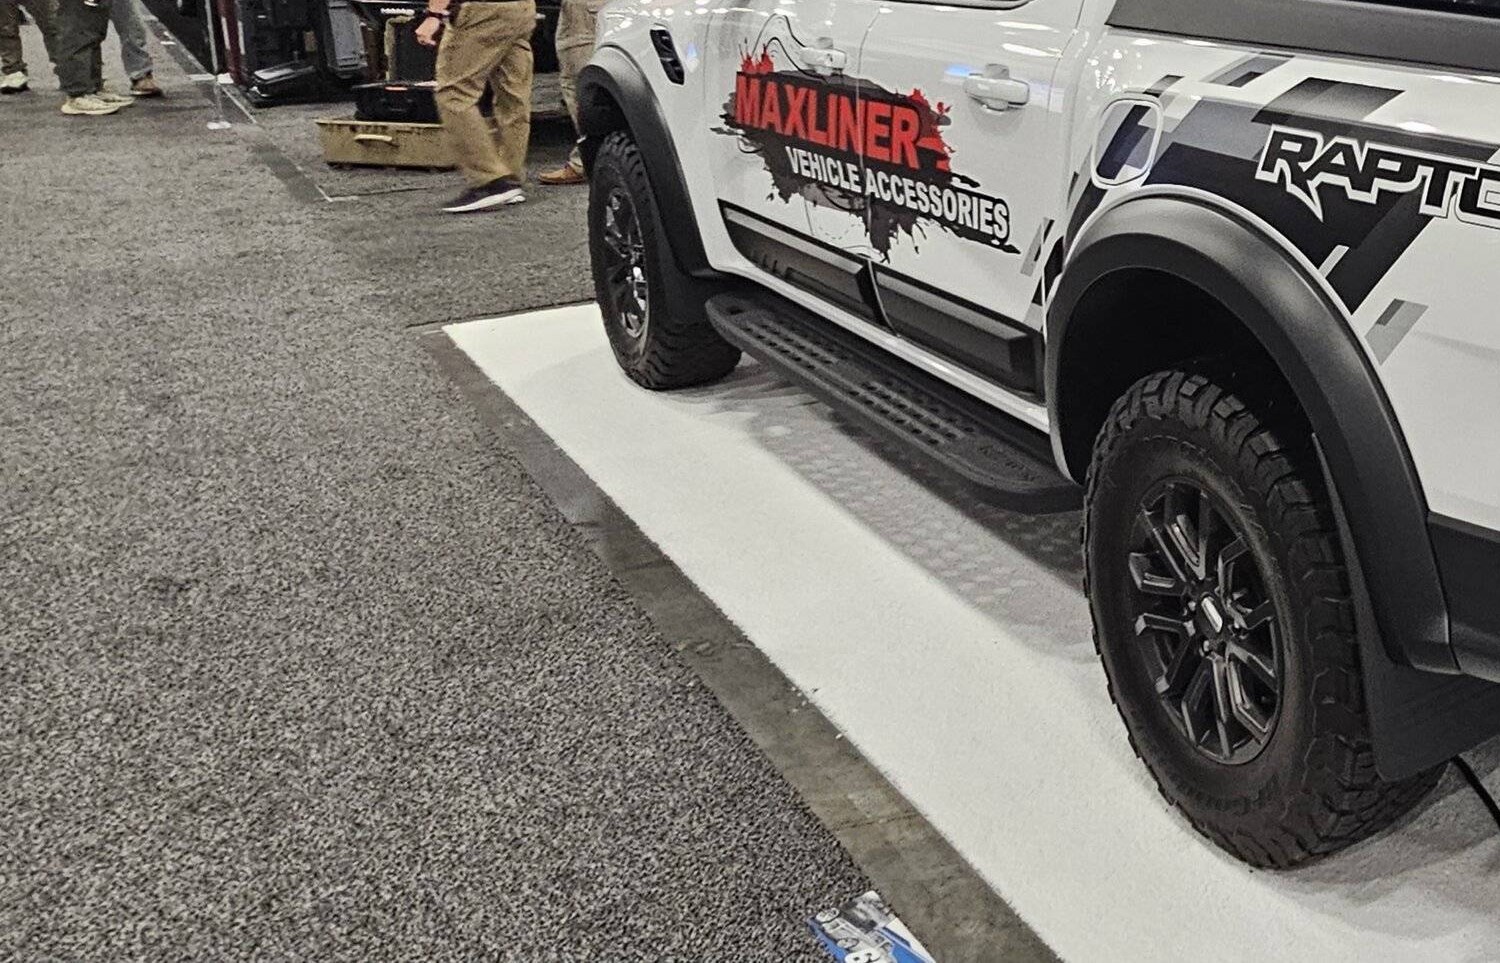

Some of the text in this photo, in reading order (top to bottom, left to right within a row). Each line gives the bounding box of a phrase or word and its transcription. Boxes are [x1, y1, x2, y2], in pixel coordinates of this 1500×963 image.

[736, 74, 921, 170] MAXLINER
[785, 146, 1010, 239] VEHICLE ACCESSORIES
